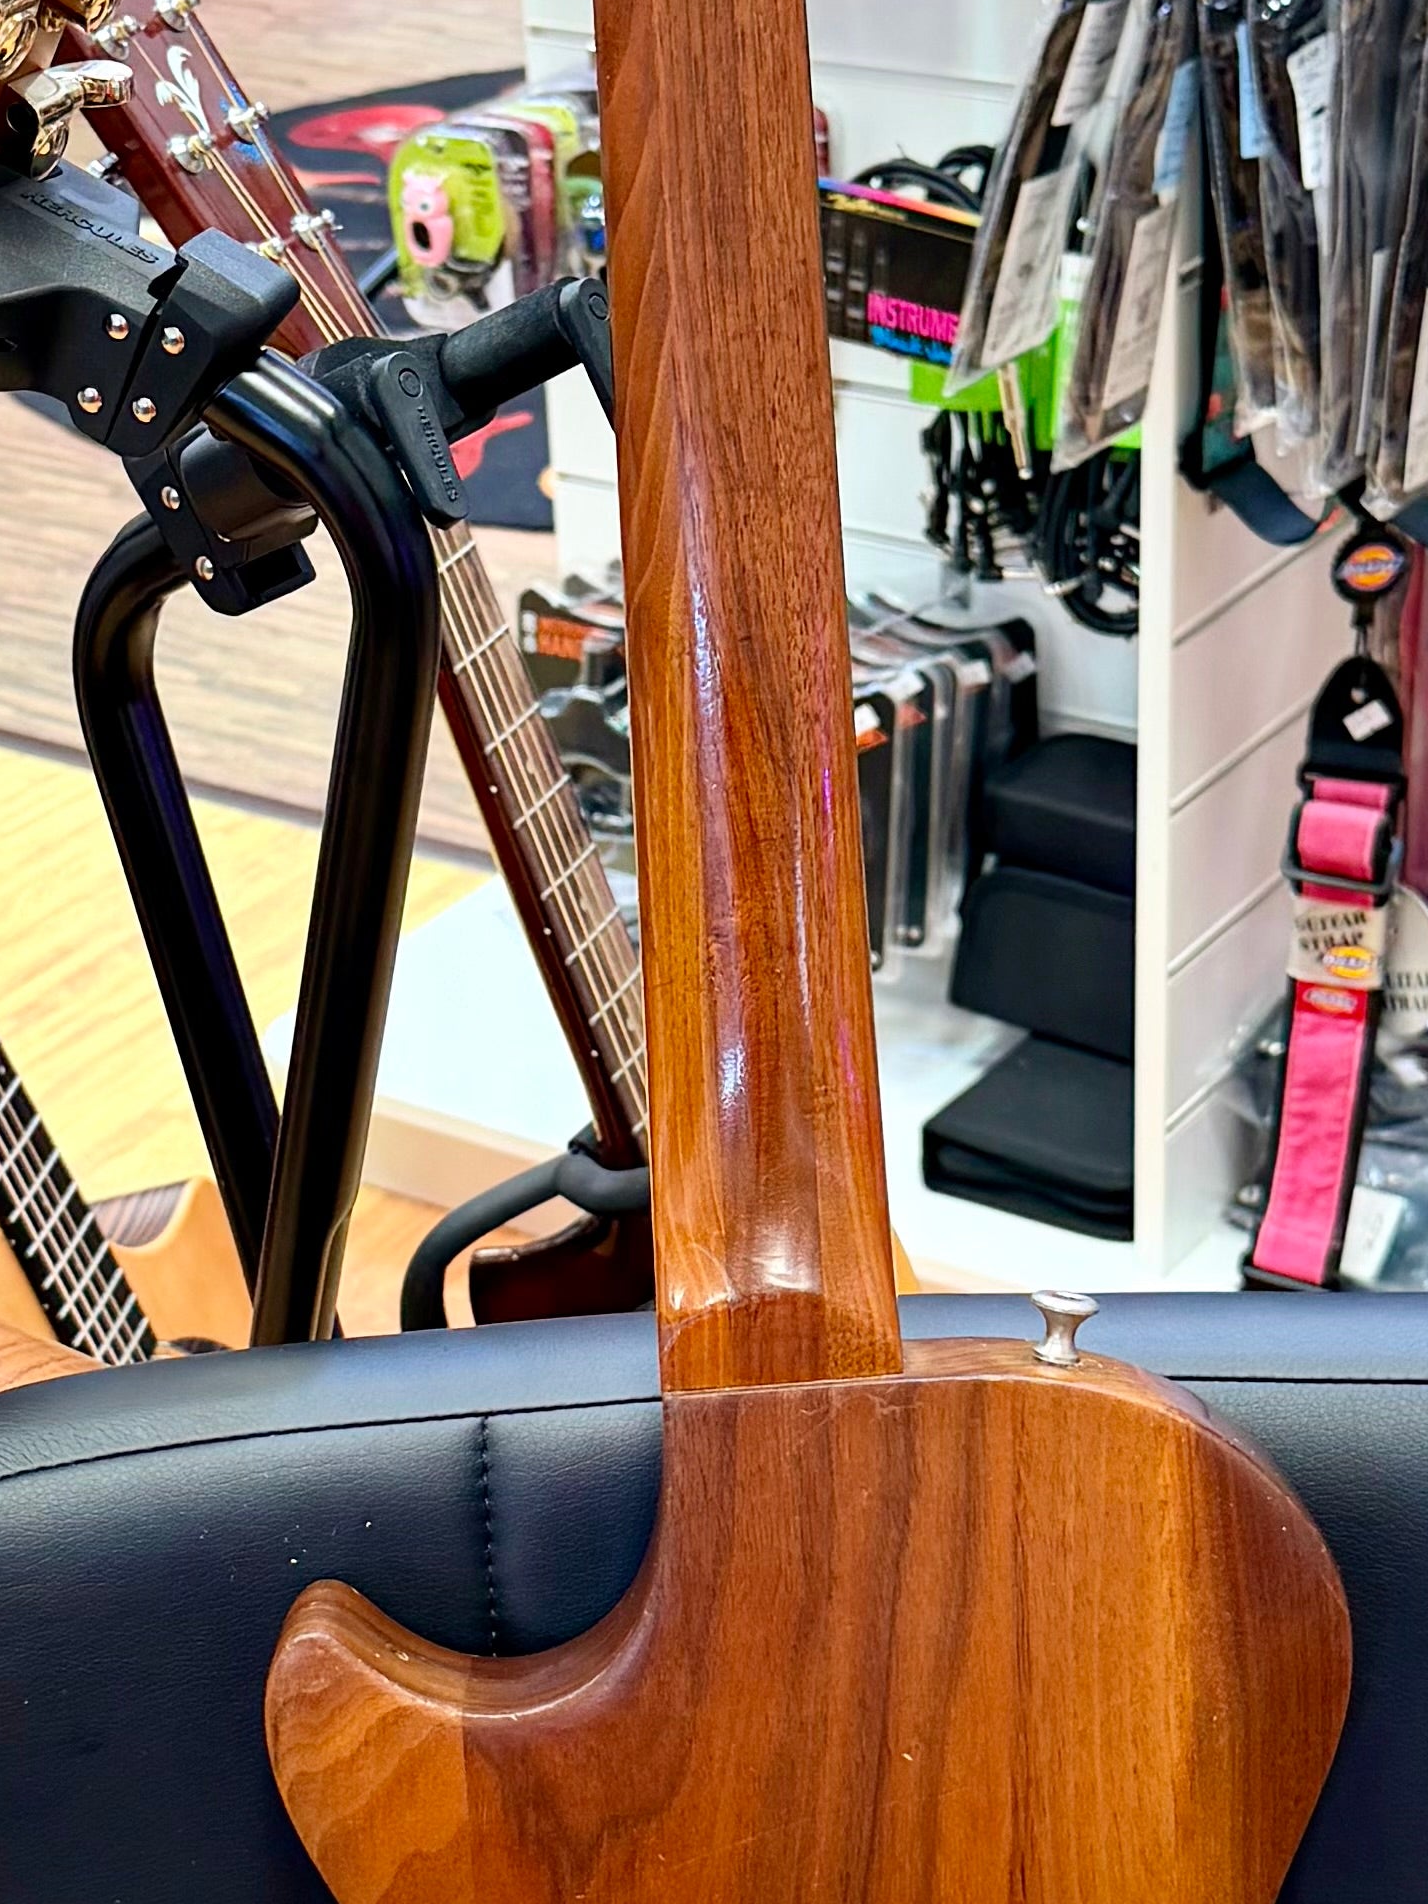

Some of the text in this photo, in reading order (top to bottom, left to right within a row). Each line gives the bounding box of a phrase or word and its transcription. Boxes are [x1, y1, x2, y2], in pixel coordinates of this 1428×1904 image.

[20, 192, 160, 265] HERCULES
[866, 291, 961, 346] INSTRUME
[417, 405, 460, 503] HERCULES
